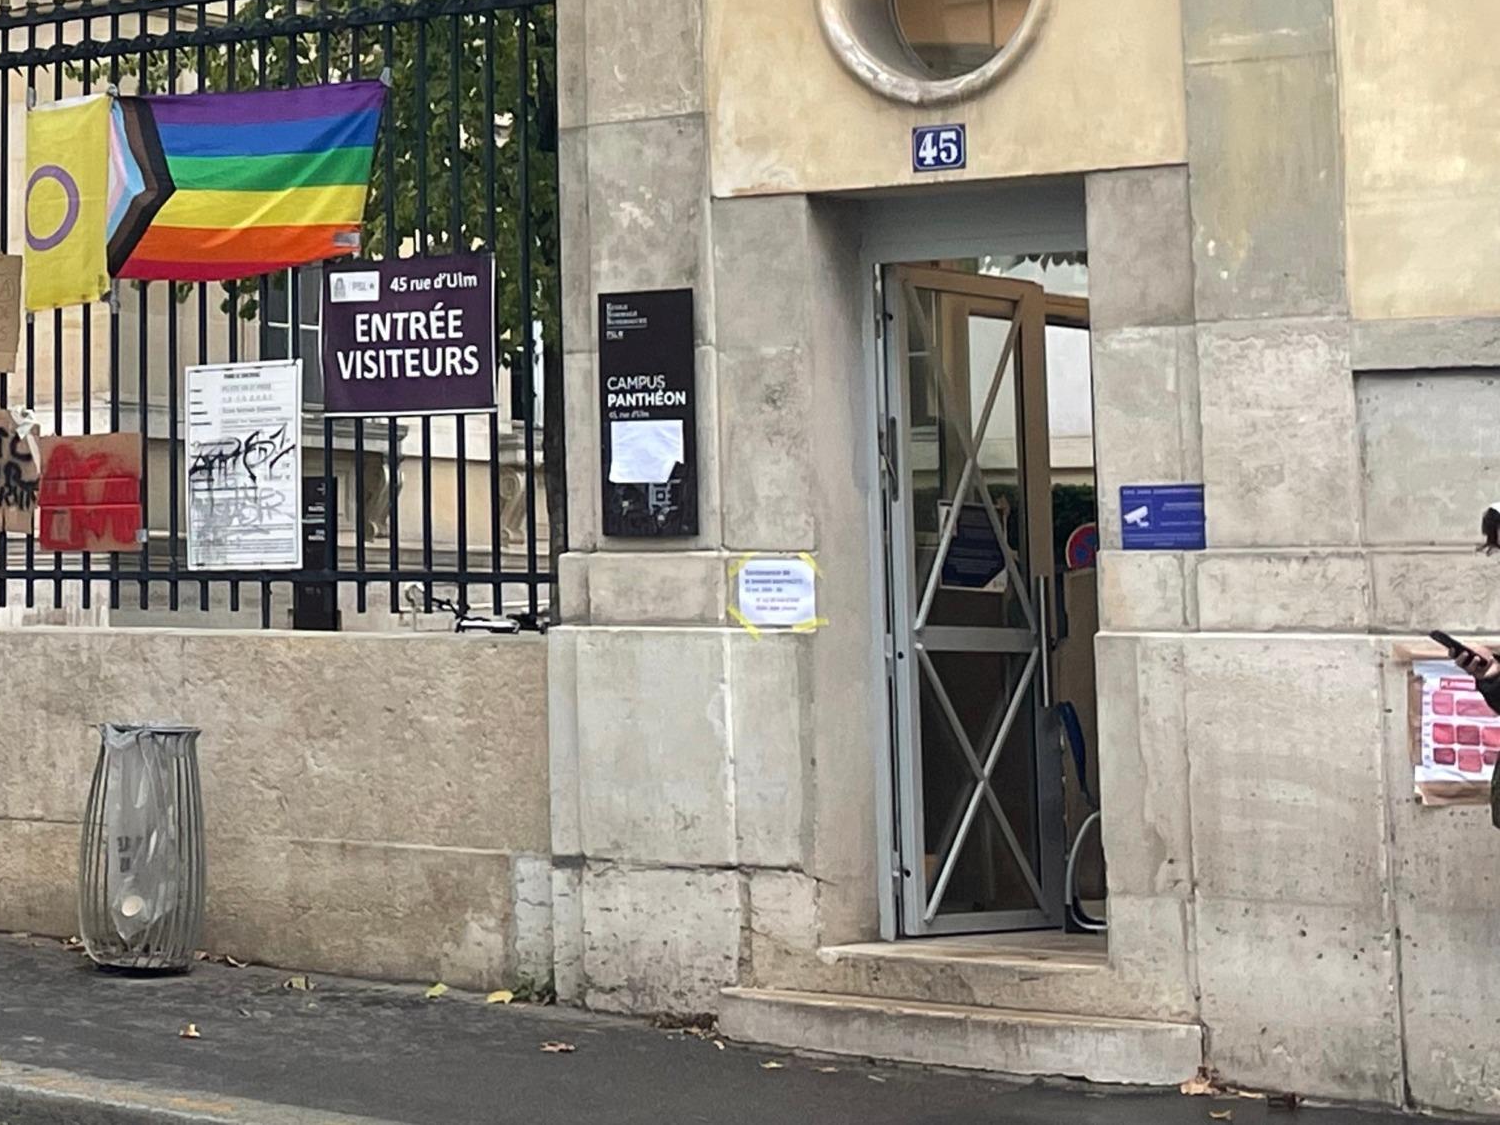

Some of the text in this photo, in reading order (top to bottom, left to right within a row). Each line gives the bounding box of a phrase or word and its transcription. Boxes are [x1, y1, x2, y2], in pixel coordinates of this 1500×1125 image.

[918, 131, 959, 165] 45
[390, 271, 477, 292] 45 rue d'Ulm
[355, 301, 464, 343] ENTRÉE
[336, 345, 480, 380] VISITEURS
[606, 375, 666, 391] CAMPUS
[607, 389, 687, 407] PANTHÉON
